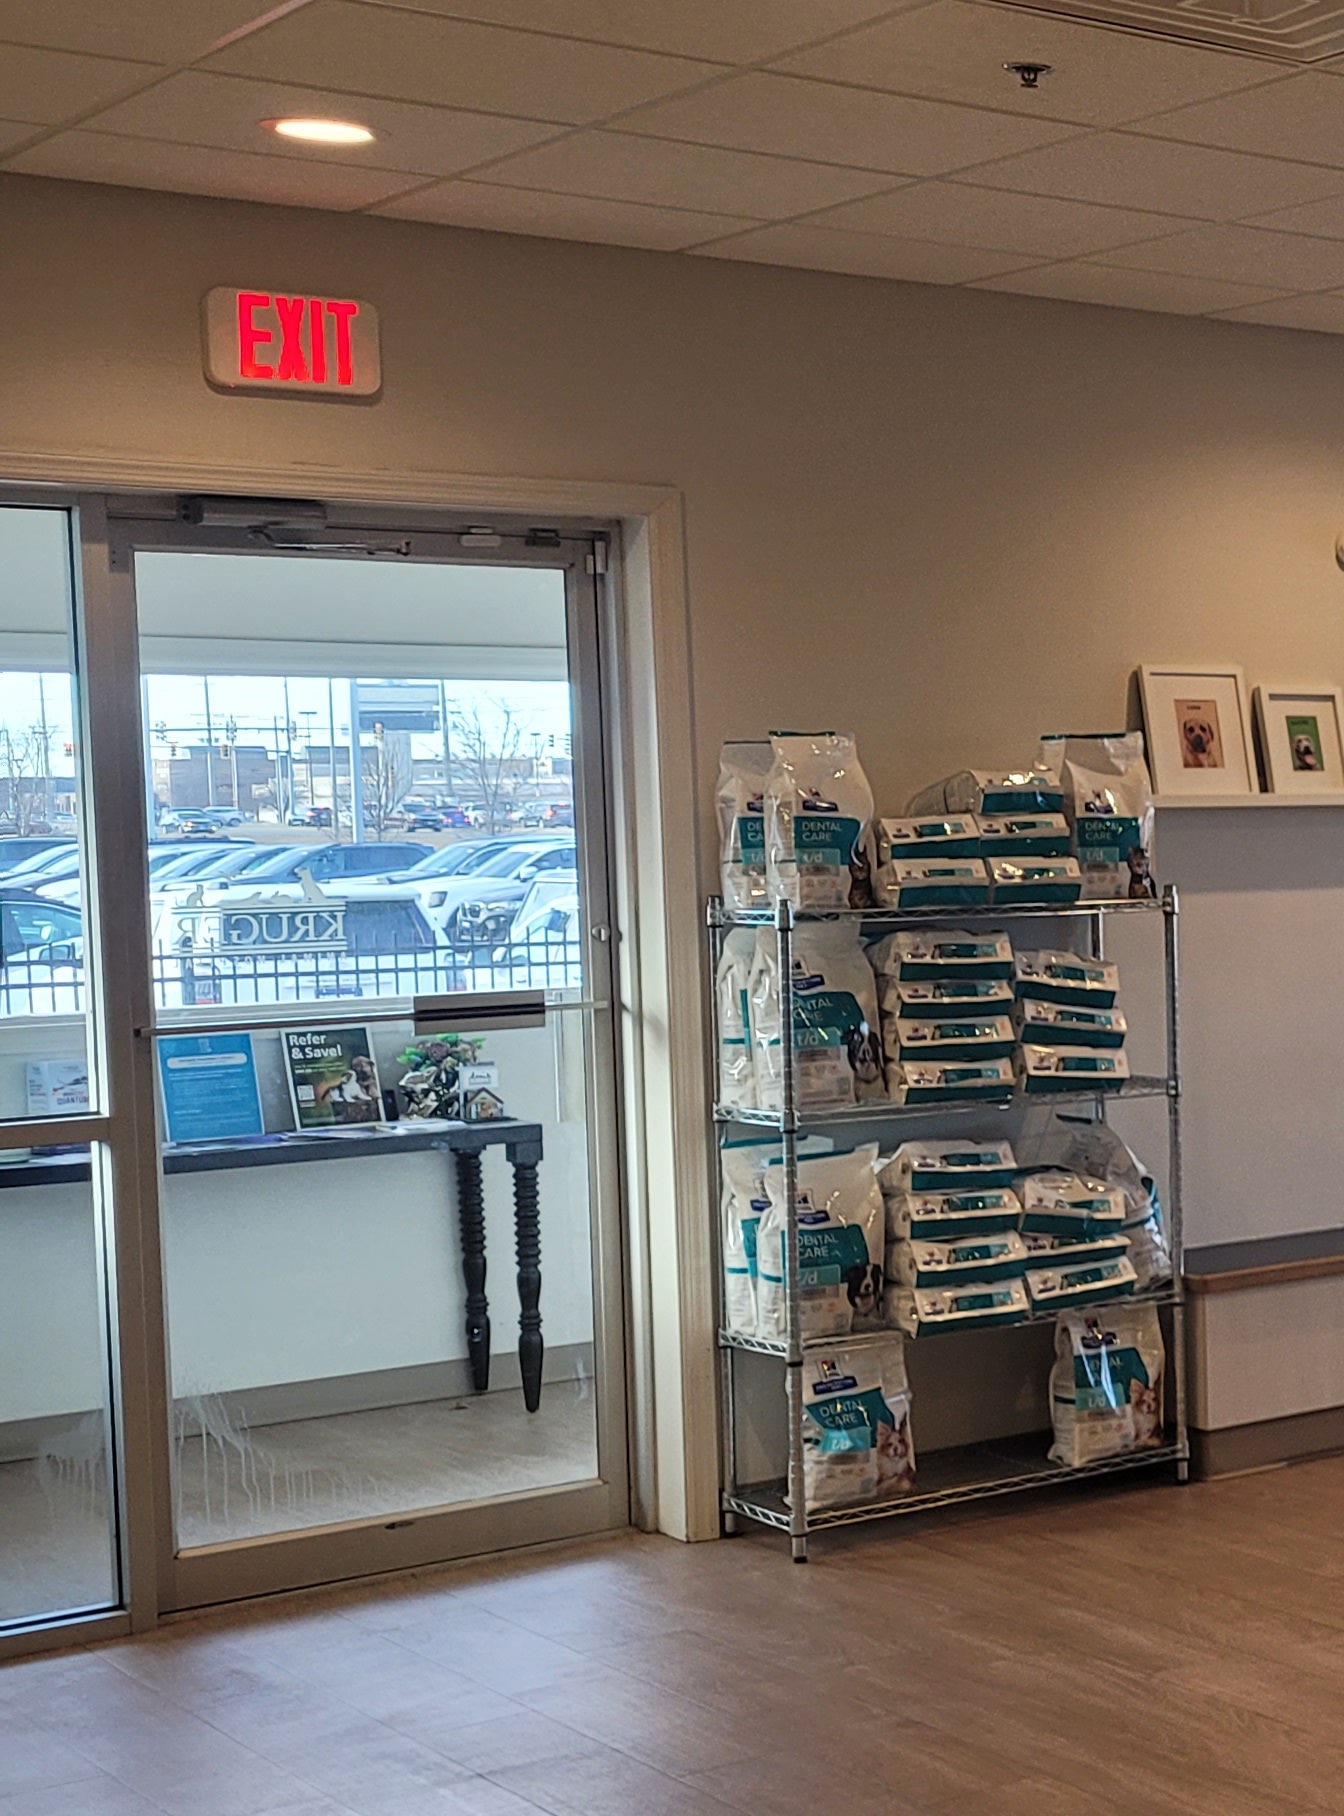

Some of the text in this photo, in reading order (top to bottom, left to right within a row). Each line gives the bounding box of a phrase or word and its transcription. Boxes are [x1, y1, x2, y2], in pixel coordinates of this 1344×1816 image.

[237, 291, 358, 385] EXIT
[802, 821, 842, 832] DENTAL
[747, 832, 764, 841] CA
[802, 832, 832, 841] CARE
[1085, 831, 1113, 841] CARE
[803, 850, 823, 863] t/d
[793, 997, 833, 1010] DTAL
[289, 1033, 326, 1046] Refer
[797, 1031, 819, 1047] t/d
[291, 1047, 304, 1059] &
[797, 1271, 818, 1285] /d
[825, 1412, 858, 1427] CARE
